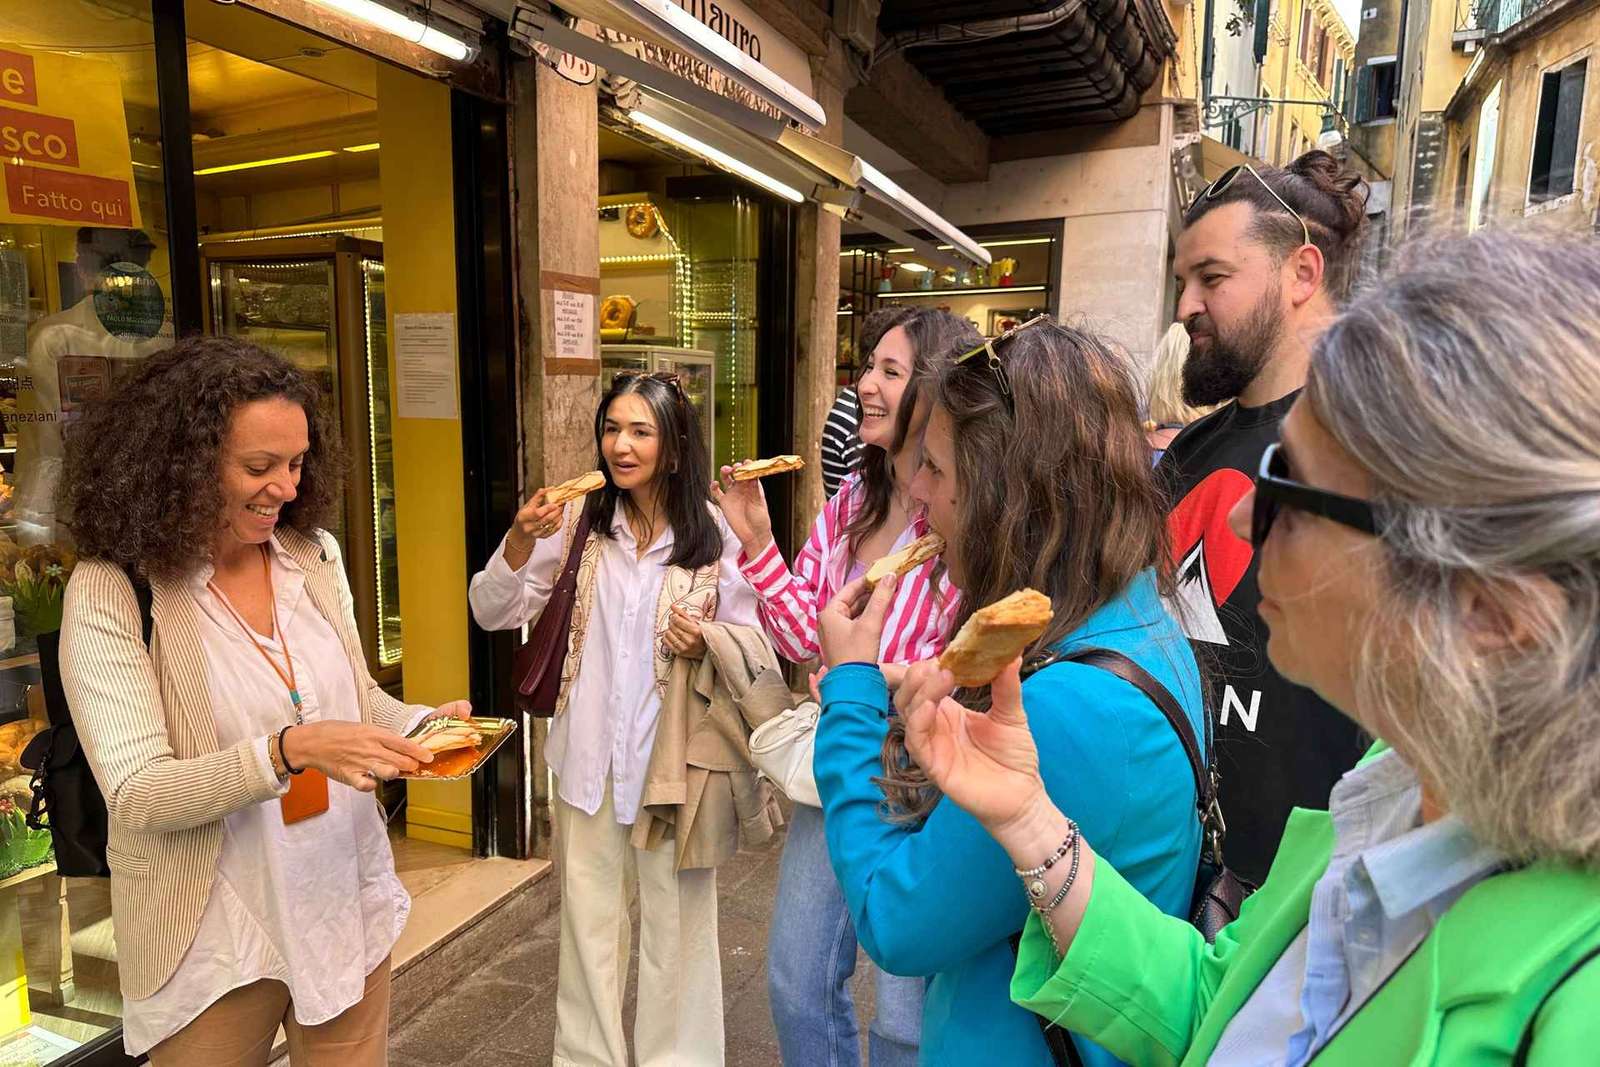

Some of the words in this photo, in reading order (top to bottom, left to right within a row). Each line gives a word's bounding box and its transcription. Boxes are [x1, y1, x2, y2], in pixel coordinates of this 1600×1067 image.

[2, 126, 67, 160] sco
[22, 184, 83, 212] Fatto
[91, 198, 123, 220] qui
[1220, 684, 1262, 732] N
